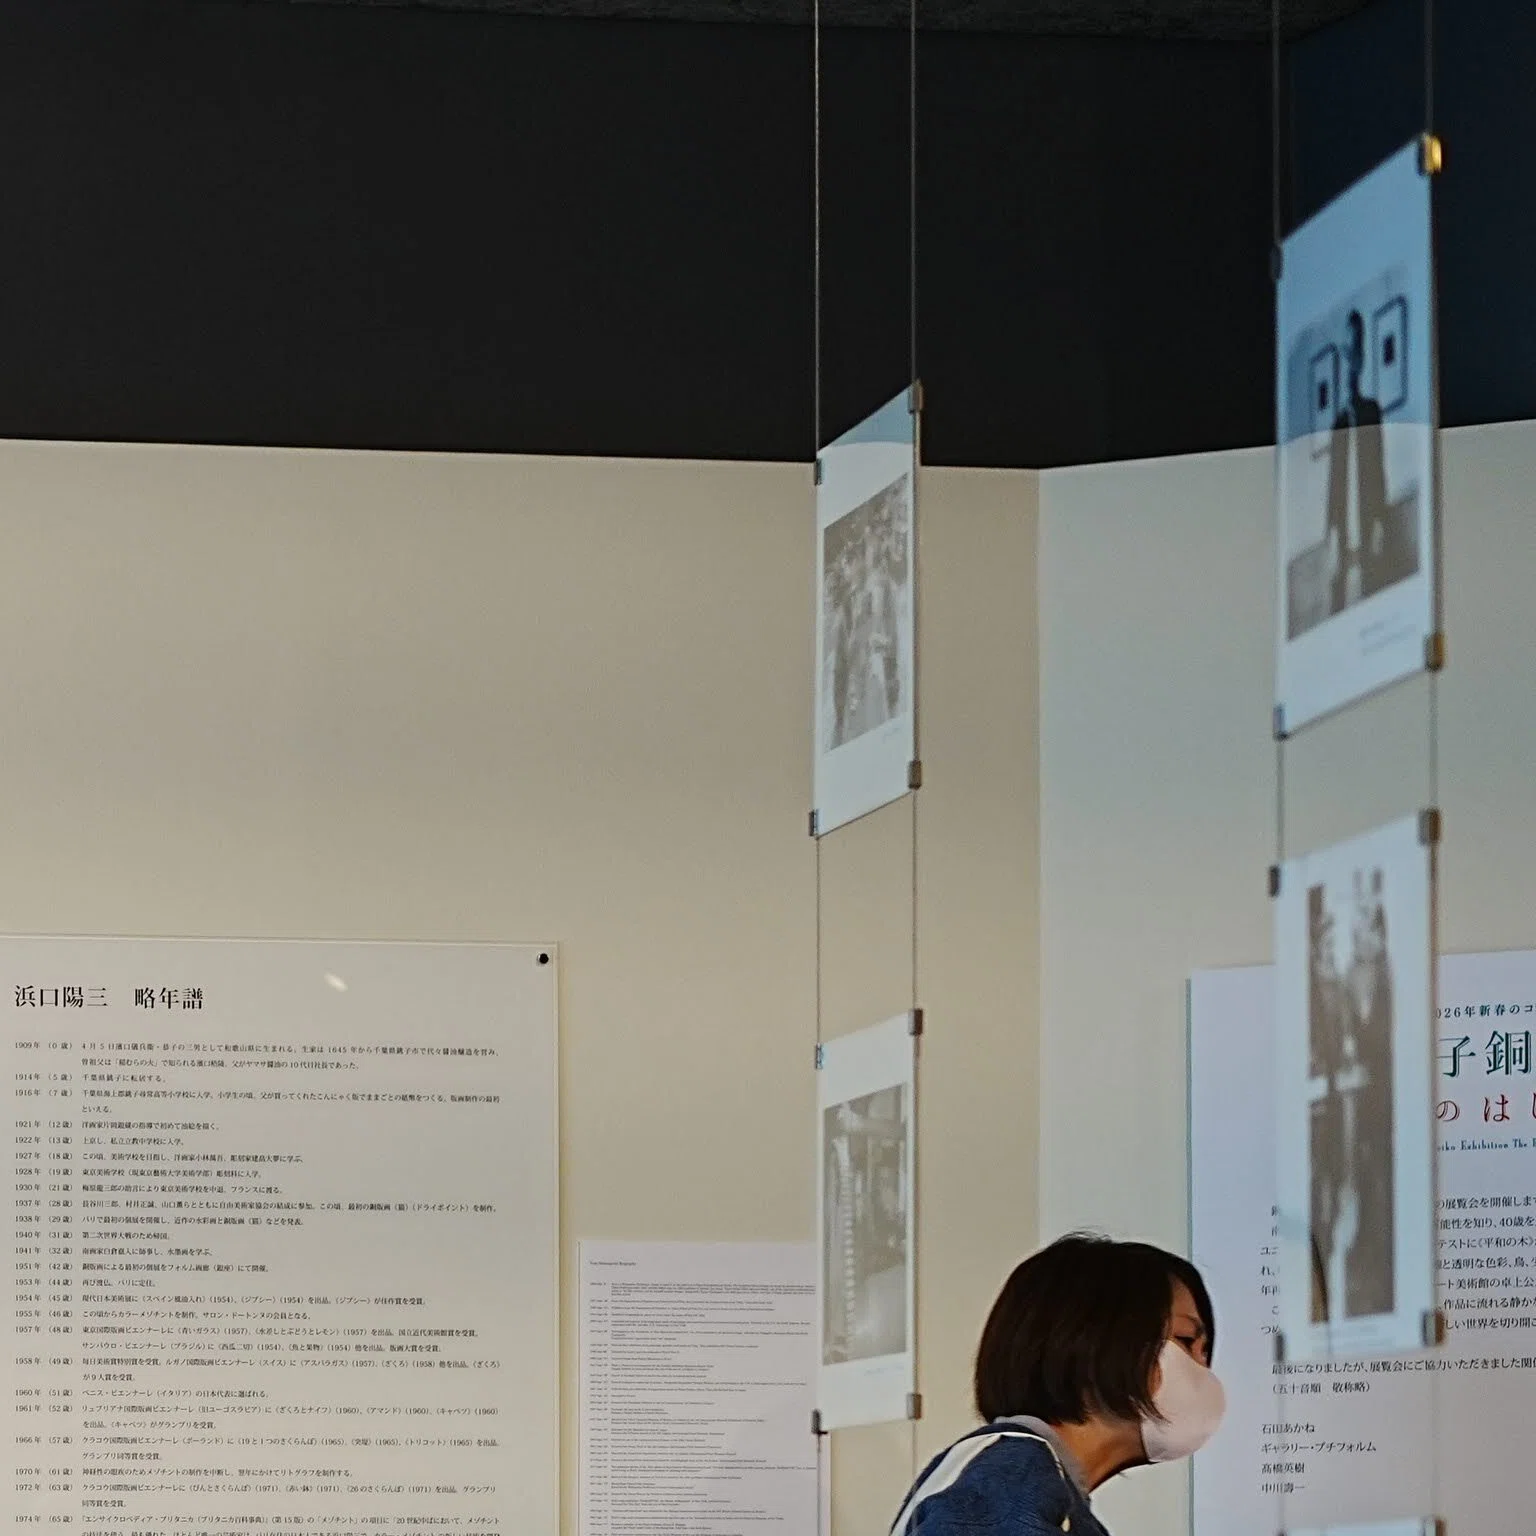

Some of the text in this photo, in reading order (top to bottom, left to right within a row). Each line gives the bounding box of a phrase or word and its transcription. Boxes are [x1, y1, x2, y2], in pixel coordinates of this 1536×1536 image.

[14, 985, 204, 1010] 浜口陽三 略年譜
[14, 1040, 41, 1050] 1909年
[14, 1072, 41, 1082] 1914年
[14, 1088, 41, 1098] 1916年
[81, 1105, 113, 1115] といえる。
[14, 1119, 41, 1129] 1921年
[14, 1135, 41, 1145] 1922年
[1460, 1138, 1528, 1151] Exhibition The
[14, 1151, 41, 1161] 1927年
[14, 1167, 41, 1177] 1928年
[14, 1183, 41, 1192] 1930年
[14, 1198, 41, 1208] 1937年
[14, 1214, 41, 1224] 1938年
[14, 1230, 41, 1240] 1940年
[81, 1231, 170, 1242] 第二次世界大戦のため帰国。
[14, 1246, 41, 1256] 1941年
[14, 1262, 41, 1272] 1951年
[14, 1278, 41, 1287] 1953年
[14, 1293, 41, 1303] 1954年
[14, 1309, 41, 1318] 1955年
[14, 1325, 41, 1334] 1957年
[14, 1356, 41, 1366] 1958年
[14, 1388, 41, 1397] 1960年
[14, 1404, 41, 1413] 1961年
[1261, 1421, 1315, 1435] 石田あかね
[14, 1435, 41, 1445] 1966年
[81, 1451, 162, 1462] グランプリ同等賞を受賞。
[14, 1467, 41, 1477] 1970年
[14, 1483, 41, 1492] 1972年
[81, 1499, 127, 1509] 同等賞を受賞。
[14, 1515, 41, 1524] 1974年
